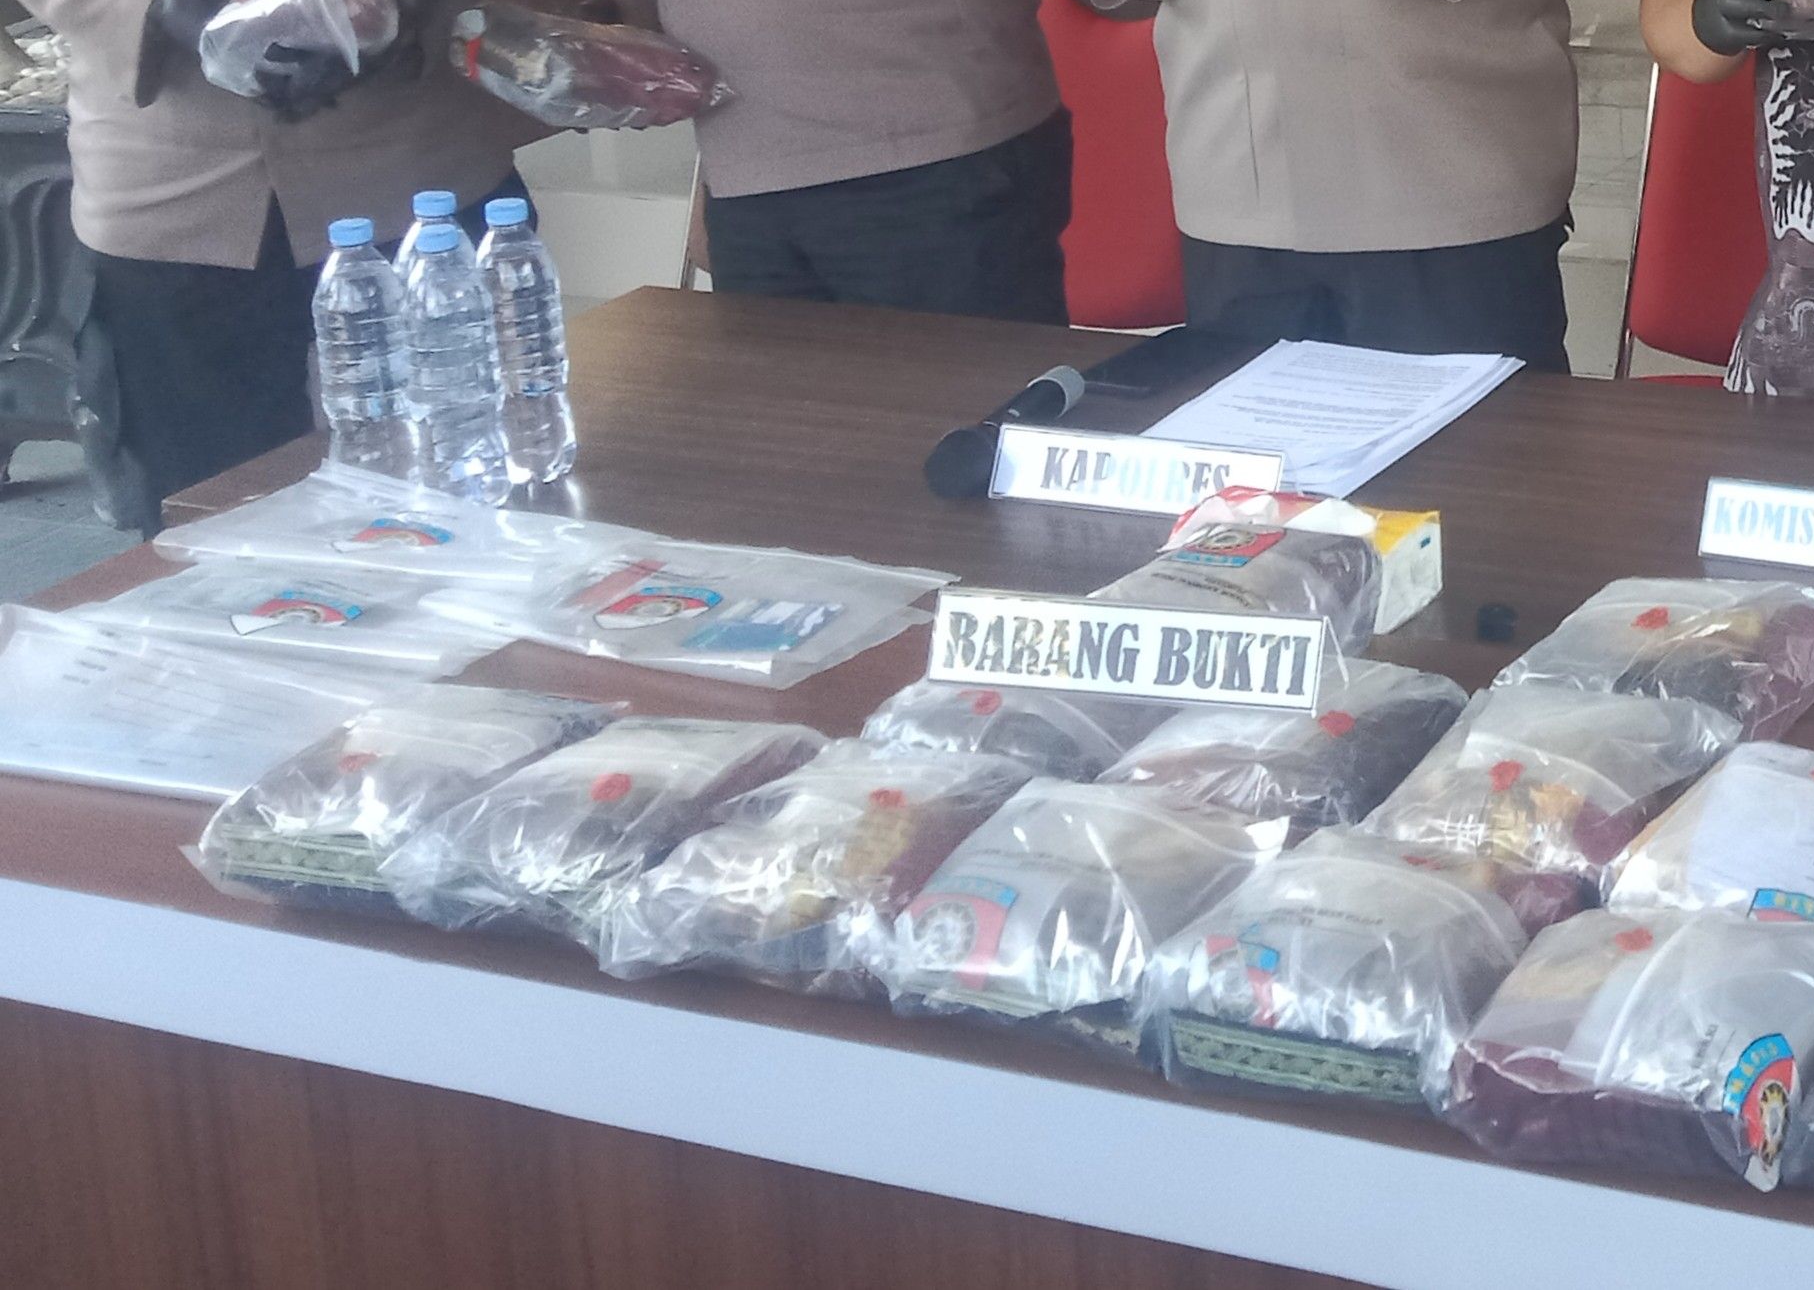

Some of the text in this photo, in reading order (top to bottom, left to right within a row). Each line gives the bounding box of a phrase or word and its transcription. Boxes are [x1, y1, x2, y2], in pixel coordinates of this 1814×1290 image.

[1040, 445, 1231, 506] KAPOLRES
[942, 609, 1314, 697] BARANG BUKTI
